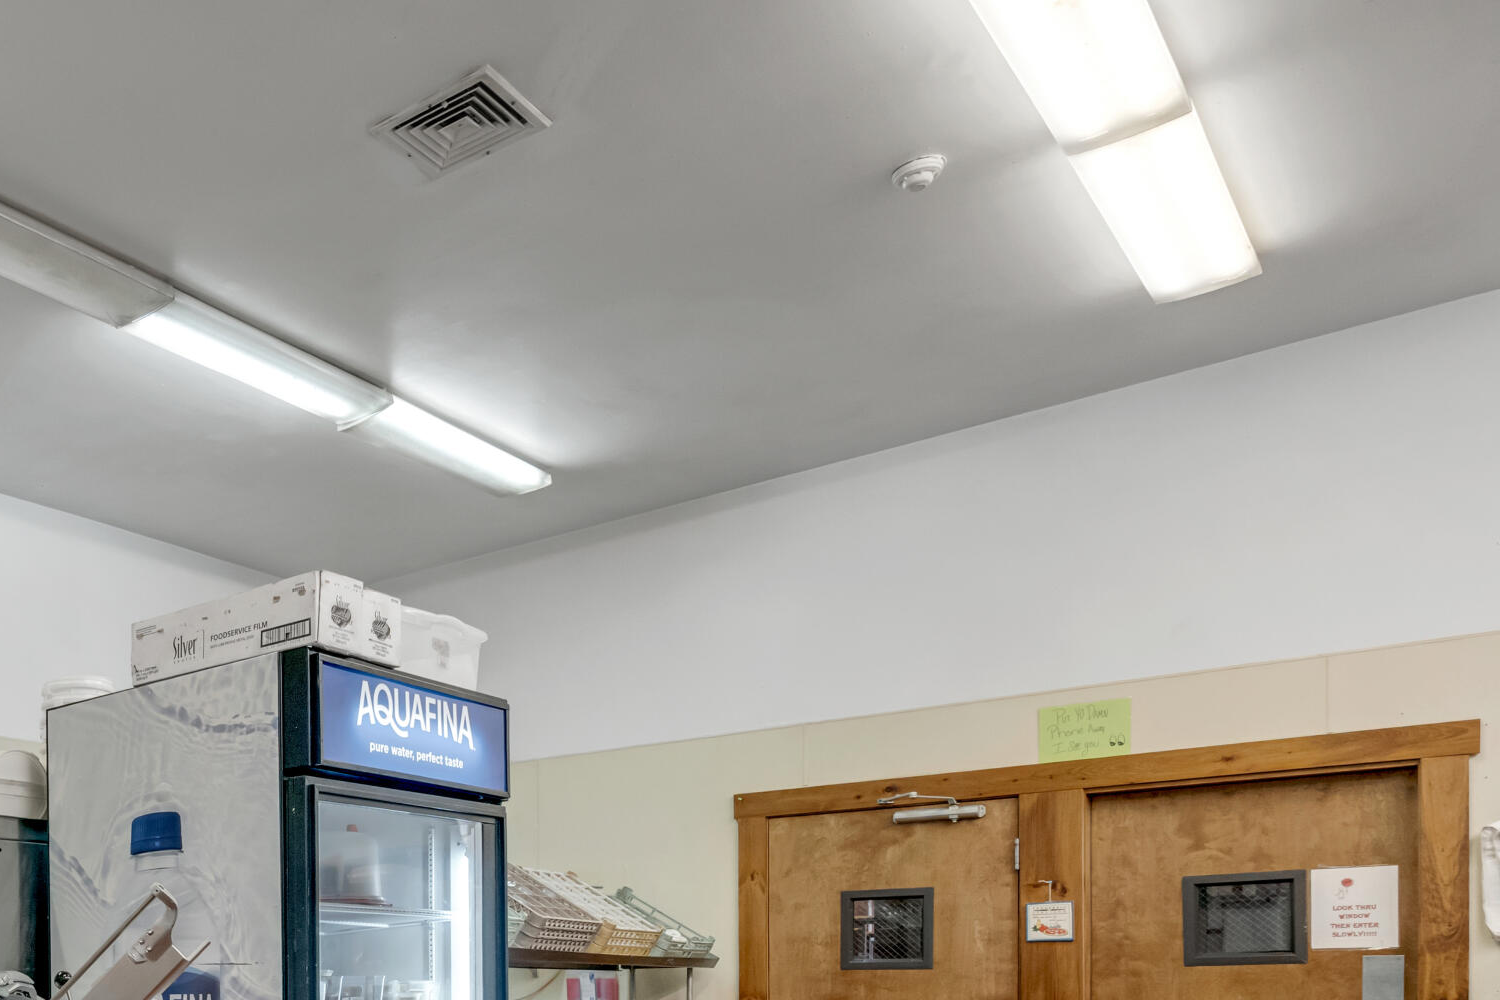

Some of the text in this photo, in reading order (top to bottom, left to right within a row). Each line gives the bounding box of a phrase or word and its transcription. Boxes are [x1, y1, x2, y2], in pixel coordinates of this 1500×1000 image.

[210, 625, 252, 642] FOODSERVICE
[253, 620, 269, 632] FILM
[172, 635, 198, 660] Silver
[357, 680, 476, 752] AQUAFINA
[369, 742, 464, 769] pure water, perfect taste
